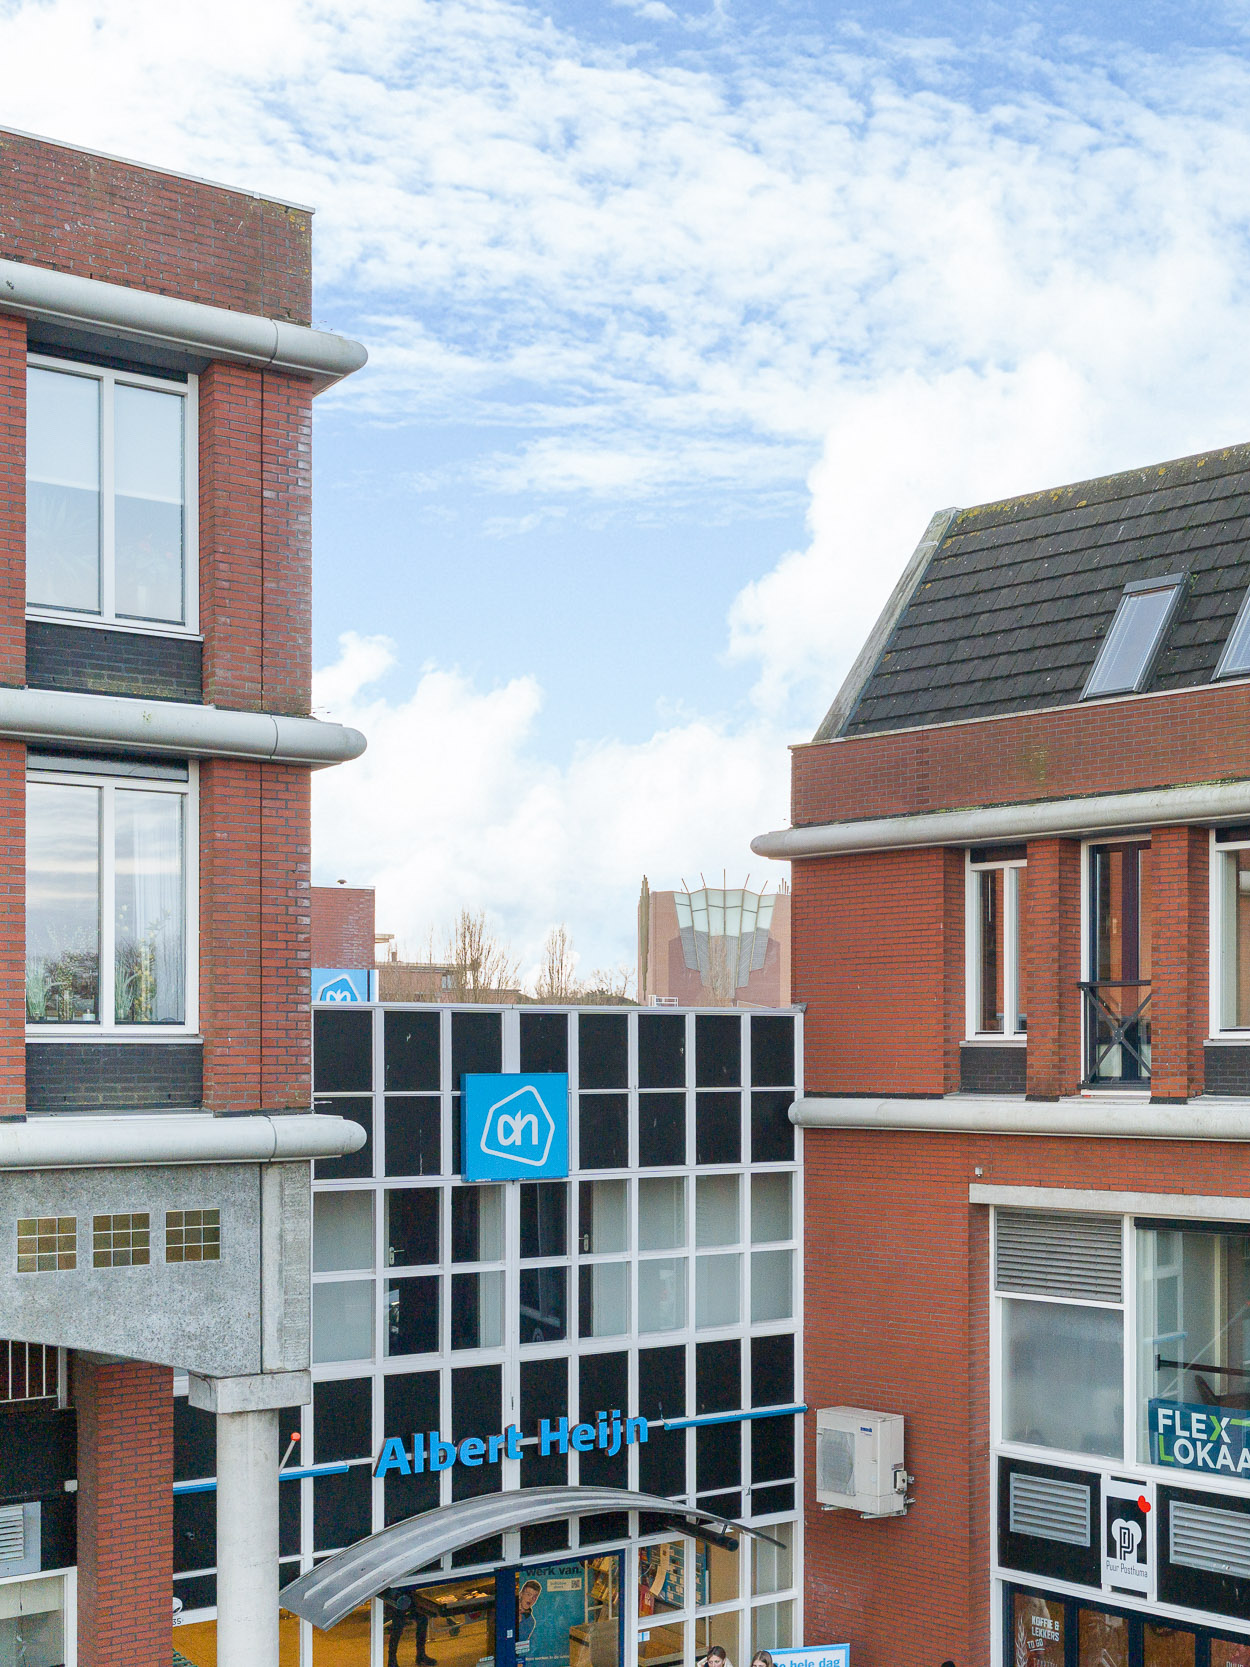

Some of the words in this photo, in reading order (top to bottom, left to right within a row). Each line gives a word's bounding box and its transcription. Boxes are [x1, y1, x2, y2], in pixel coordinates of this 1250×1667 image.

[1157, 1407, 1232, 1444] FLEX
[373, 1423, 524, 1478] Albert
[538, 1409, 649, 1458] Heijn
[1106, 1560, 1119, 1572] Puur
[1121, 1563, 1148, 1578] Posthuma
[1031, 1615, 1054, 1630] KOFFIE
[1031, 1626, 1060, 1642] LEKKERS
[1027, 1640, 1035, 1649] TO
[1036, 1638, 1044, 1648] GO
